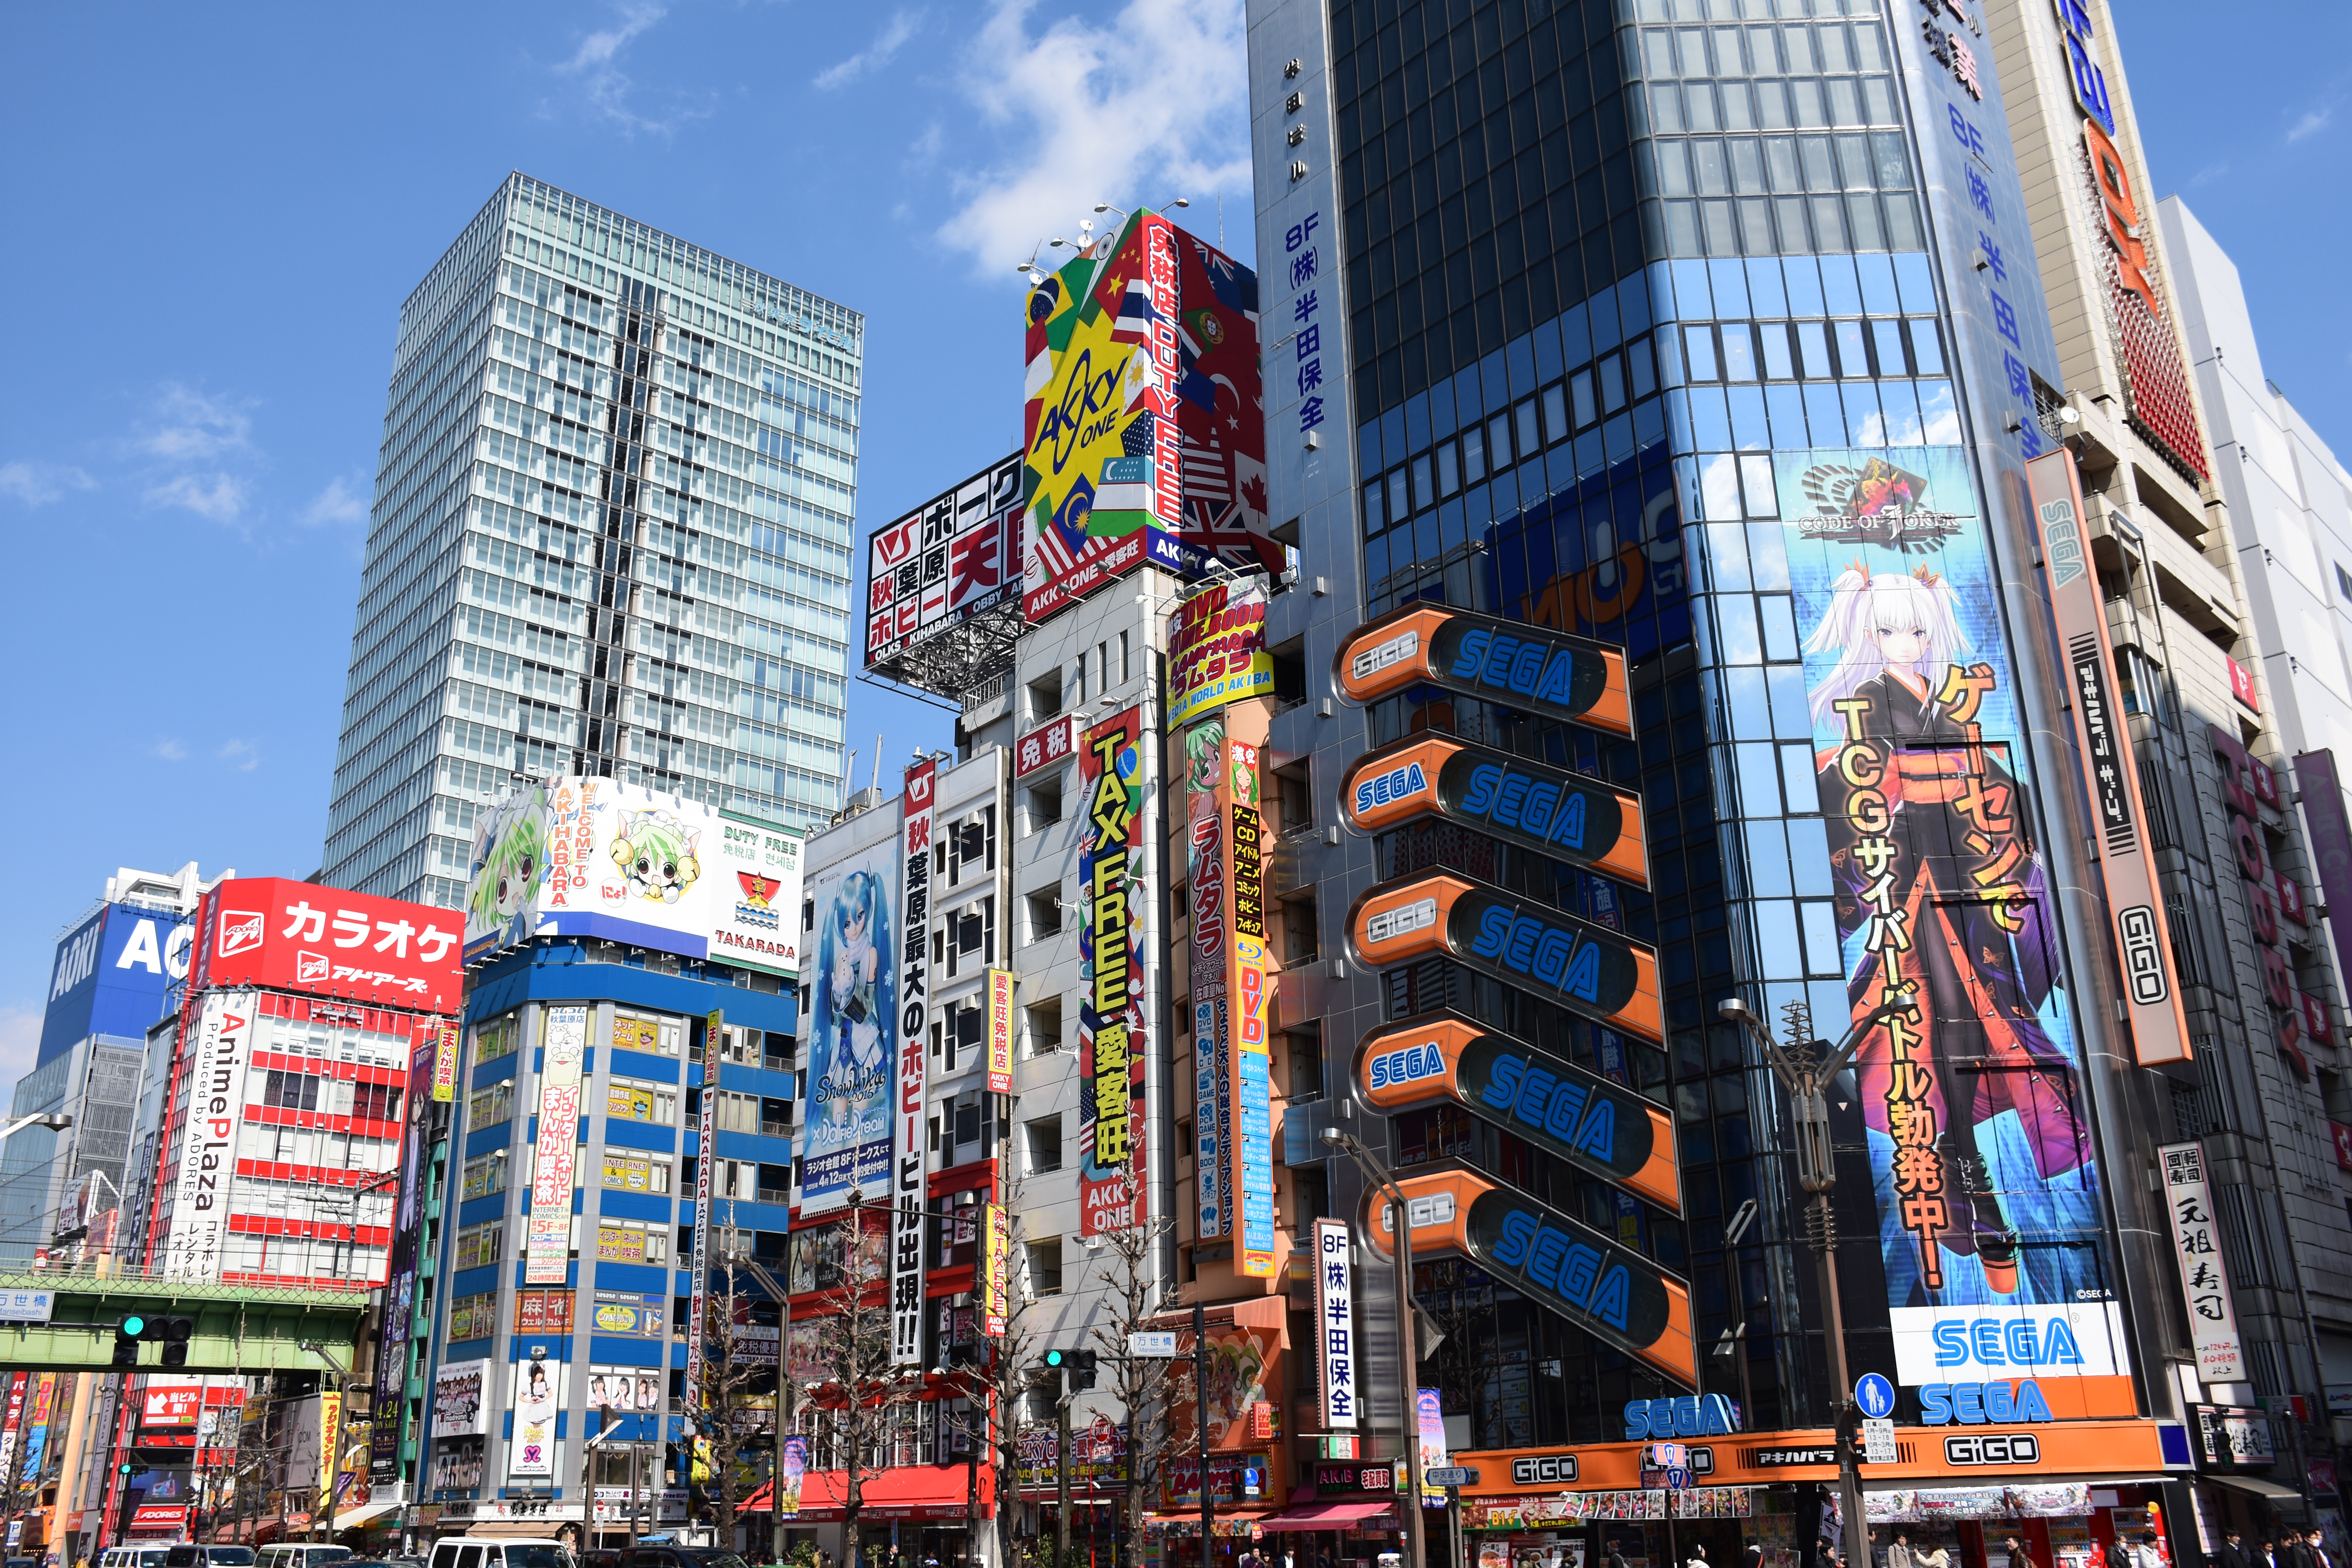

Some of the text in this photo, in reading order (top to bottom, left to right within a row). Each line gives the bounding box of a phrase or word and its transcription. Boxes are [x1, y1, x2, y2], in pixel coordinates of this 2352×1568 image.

[1284, 58, 1306, 183] 半田ビル
[1948, 103, 1984, 155] 8F
[1286, 212, 1318, 252] 8F
[1289, 247, 1318, 290] (株)
[1295, 291, 1325, 433] 半田保全
[1081, 408, 1119, 449] ONE
[1798, 503, 1960, 541] CODE OF JOKER
[2039, 497, 2083, 591] SEGA
[871, 545, 946, 612] 秋葉原
[1069, 564, 1099, 590] ONE
[870, 593, 944, 649] ホビー
[1181, 585, 1228, 628] DVD
[869, 588, 1003, 664] VOLKS AKIHABARA HOBBY
[1353, 630, 1418, 681] GiGO
[1451, 629, 1572, 706] SEGA
[1191, 671, 1271, 708] WORLD AKIBA
[2079, 663, 2111, 757] アキハバラ
[1021, 722, 1066, 772] 免税
[1231, 745, 1256, 764] 激安
[1092, 732, 1128, 852] TAX
[1357, 762, 1428, 815] SEGA
[1936, 662, 2027, 935] ゲーセンで
[1234, 806, 1258, 825] ゲーム
[1461, 763, 1586, 851] SEGA
[551, 787, 573, 907] AKIHABARA
[572, 782, 598, 889] WELCOME TO
[724, 826, 798, 855] DUTY FREE
[1237, 828, 1255, 842] CD
[722, 843, 756, 861] 免税店
[1234, 843, 1259, 861] アイドル
[752, 877, 767, 893] 宝
[1234, 861, 1260, 878] アニメ
[601, 884, 628, 901] にょ!
[1192, 814, 1225, 960] ラムタラ
[1236, 880, 1259, 897] コミック
[1238, 898, 1260, 914] ホビー
[1367, 897, 1437, 944] GiGO
[197, 895, 216, 985] カラオケ
[282, 901, 457, 962] カラオケ
[1094, 851, 1127, 1014] FREE
[1237, 917, 1261, 934] フィギュア
[464, 938, 497, 959] GAMERS
[716, 929, 796, 959] TAKARADA
[1472, 904, 1600, 1004] SEGA
[2118, 904, 2169, 1006] GiGO
[51, 921, 100, 1003] AOKI
[1203, 971, 1219, 984] アキバ
[331, 965, 428, 994] アドアーズ
[550, 1014, 585, 1024] 秋葉原店
[1240, 965, 1264, 1045] DVD
[613, 1029, 634, 1043] ゲーム
[614, 1019, 635, 1030] ネット
[994, 973, 1009, 1071] 愛客旺免税店
[1198, 1019, 1212, 1028] DVD
[436, 1029, 457, 1087] まんが喫茶
[613, 1040, 634, 1048] NETGAME
[705, 1025, 717, 1083] まんが喫茶
[990, 1074, 1010, 1082] AKKY
[1370, 1041, 1446, 1091] SEGA
[849, 1088, 874, 1104] 2015
[895, 815, 930, 1356] 秋葉原最大のホビービル出現!!
[992, 1081, 1008, 1090] ONE
[1198, 1090, 1215, 1100] GAME
[183, 1023, 219, 1201] Produced by ADORES
[195, 1012, 246, 1211] AnimePlaza
[1481, 1054, 1614, 1163] SEGA
[1199, 1123, 1216, 1134] GAME
[534, 1086, 563, 1206] まんが喫茶
[555, 1085, 579, 1206] インターネット
[698, 1111, 712, 1200] TAKARADA
[806, 1152, 852, 1176] ラジオ会館 8F
[1200, 1157, 1216, 1167] BOOK
[604, 1176, 624, 1186] COMICS
[1201, 1189, 1217, 1201] フィギュア
[1202, 1225, 1216, 1236] トレカ
[1323, 1234, 1347, 1253] 8F
[693, 1248, 705, 1291] 免税商店
[1492, 1209, 1631, 1333] SEGA
[2176, 1196, 2225, 1321] 元祖寿司
[818, 1271, 837, 1282] vallejo
[1324, 1261, 1348, 1292] (株)
[522, 1298, 568, 1317] 麻雀
[1137, 1336, 1172, 1346] 万世橋
[1932, 1317, 2085, 1367] SEGA
[1328, 1298, 1352, 1417] 半田保全
[2203, 1352, 2237, 1363] 60種類
[2212, 1365, 2232, 1375] 以上
[8, 1379, 25, 1418] パセラ
[34, 1381, 53, 1421] DVD
[169, 1392, 197, 1403] 当ビル
[377, 1400, 399, 1419] 4.24
[1919, 1379, 2054, 1425] SEGA
[376, 1419, 397, 1430] ON SALE
[524, 1426, 544, 1435] No.1
[1624, 1393, 1738, 1440] SEGA
[323, 1404, 338, 1474] ラジオセンター
[1666, 1446, 1674, 1460] 17
[1943, 1433, 2041, 1466] GiGO
[1176, 1455, 1200, 1473] DVD
[1511, 1454, 1579, 1485] GiGO
[1758, 1450, 1835, 1463] アキハバラ
[1361, 1469, 1390, 1489] 宅配買取
[1432, 1470, 1462, 1479] 中央通り
[1644, 1472, 1666, 1482] 中央通り
[1669, 1470, 1681, 1484] 17
[11, 1524, 20, 1533] P
[139, 1510, 183, 1519] ADORES
[1491, 1510, 1506, 1526] B1
